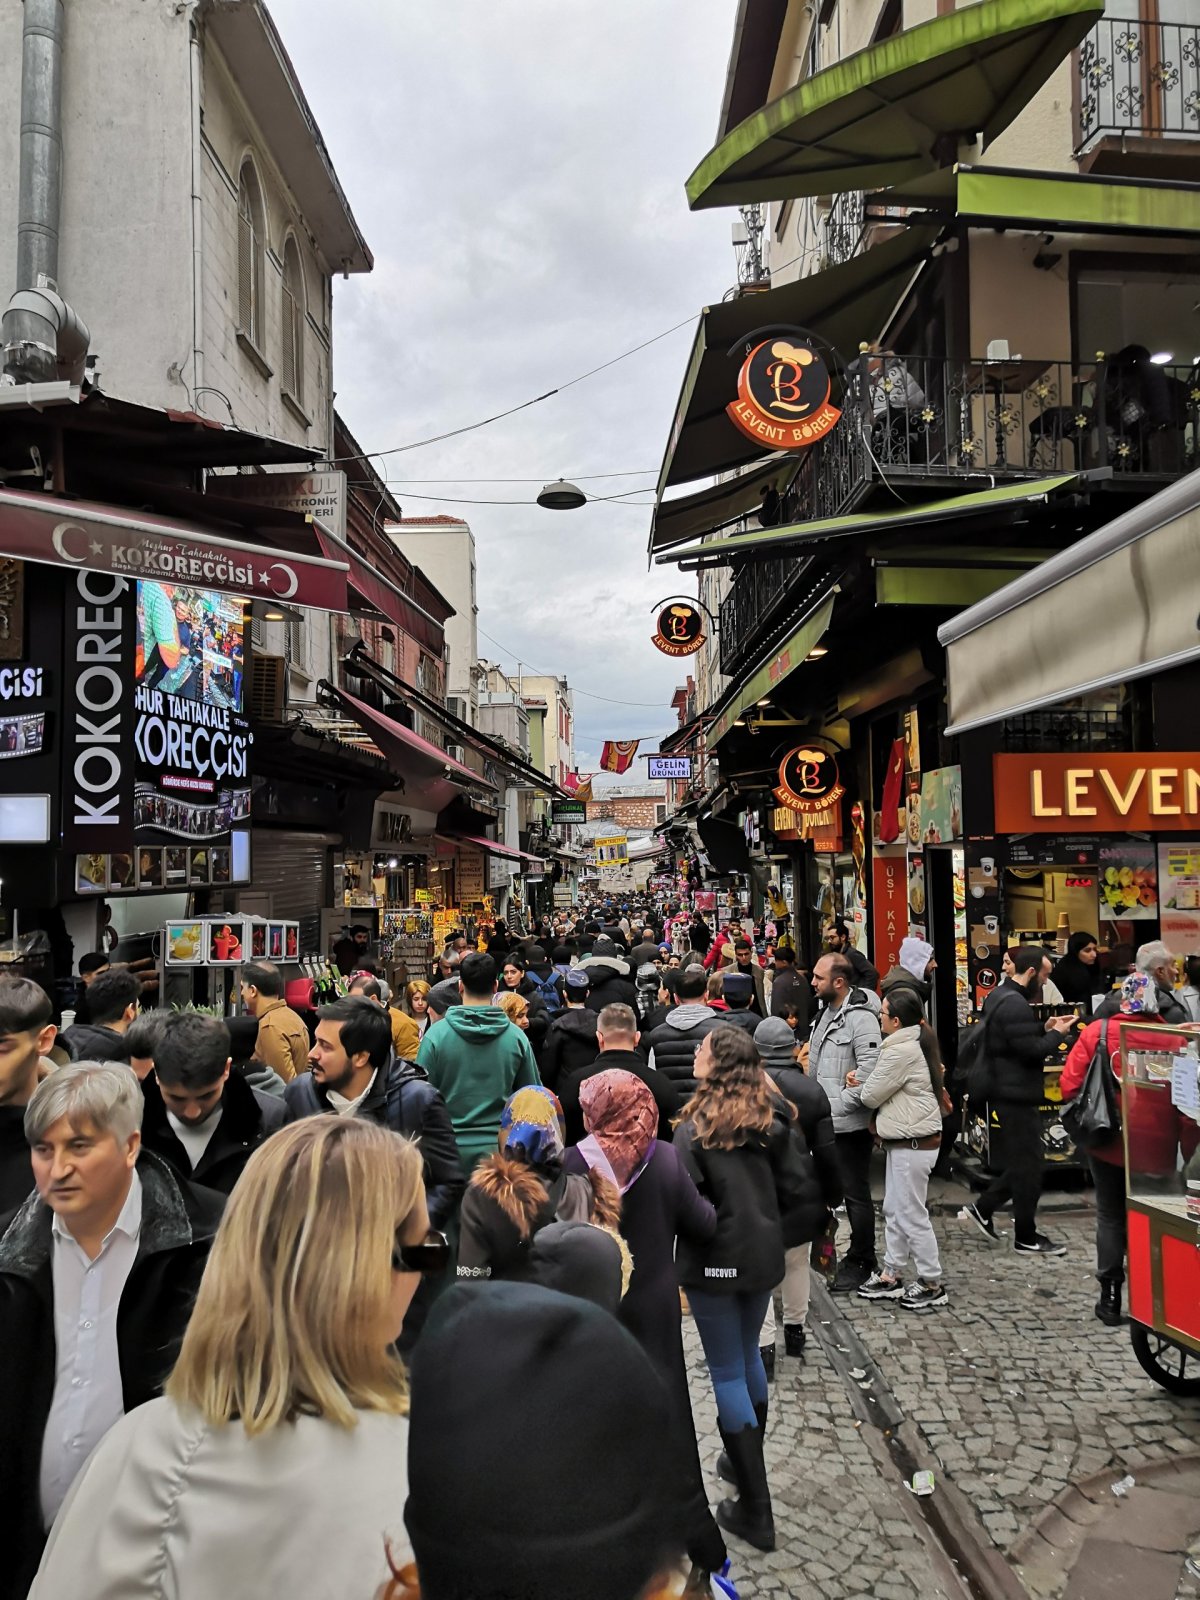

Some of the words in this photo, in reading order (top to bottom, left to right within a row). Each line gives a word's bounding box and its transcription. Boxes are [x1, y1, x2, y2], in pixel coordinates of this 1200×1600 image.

[735, 402, 785, 440] LEVENT
[792, 409, 835, 441] BÖREK
[111, 544, 254, 585] KOKOREÇÇİSİ
[175, 543, 228, 563] Tahtakale
[654, 635, 679, 653] LEVENT
[682, 635, 705, 654] BÖREK
[167, 694, 230, 731] TAHTAKALE
[651, 768, 689, 777] ÜRÜNLERİ
[656, 760, 685, 769] GELİN
[777, 788, 810, 810] LEVENT
[815, 787, 843, 810] BÖREK
[886, 865, 895, 900] ÜST
[887, 910, 896, 942] KAT
[704, 1266, 738, 1278] DISCOVER
